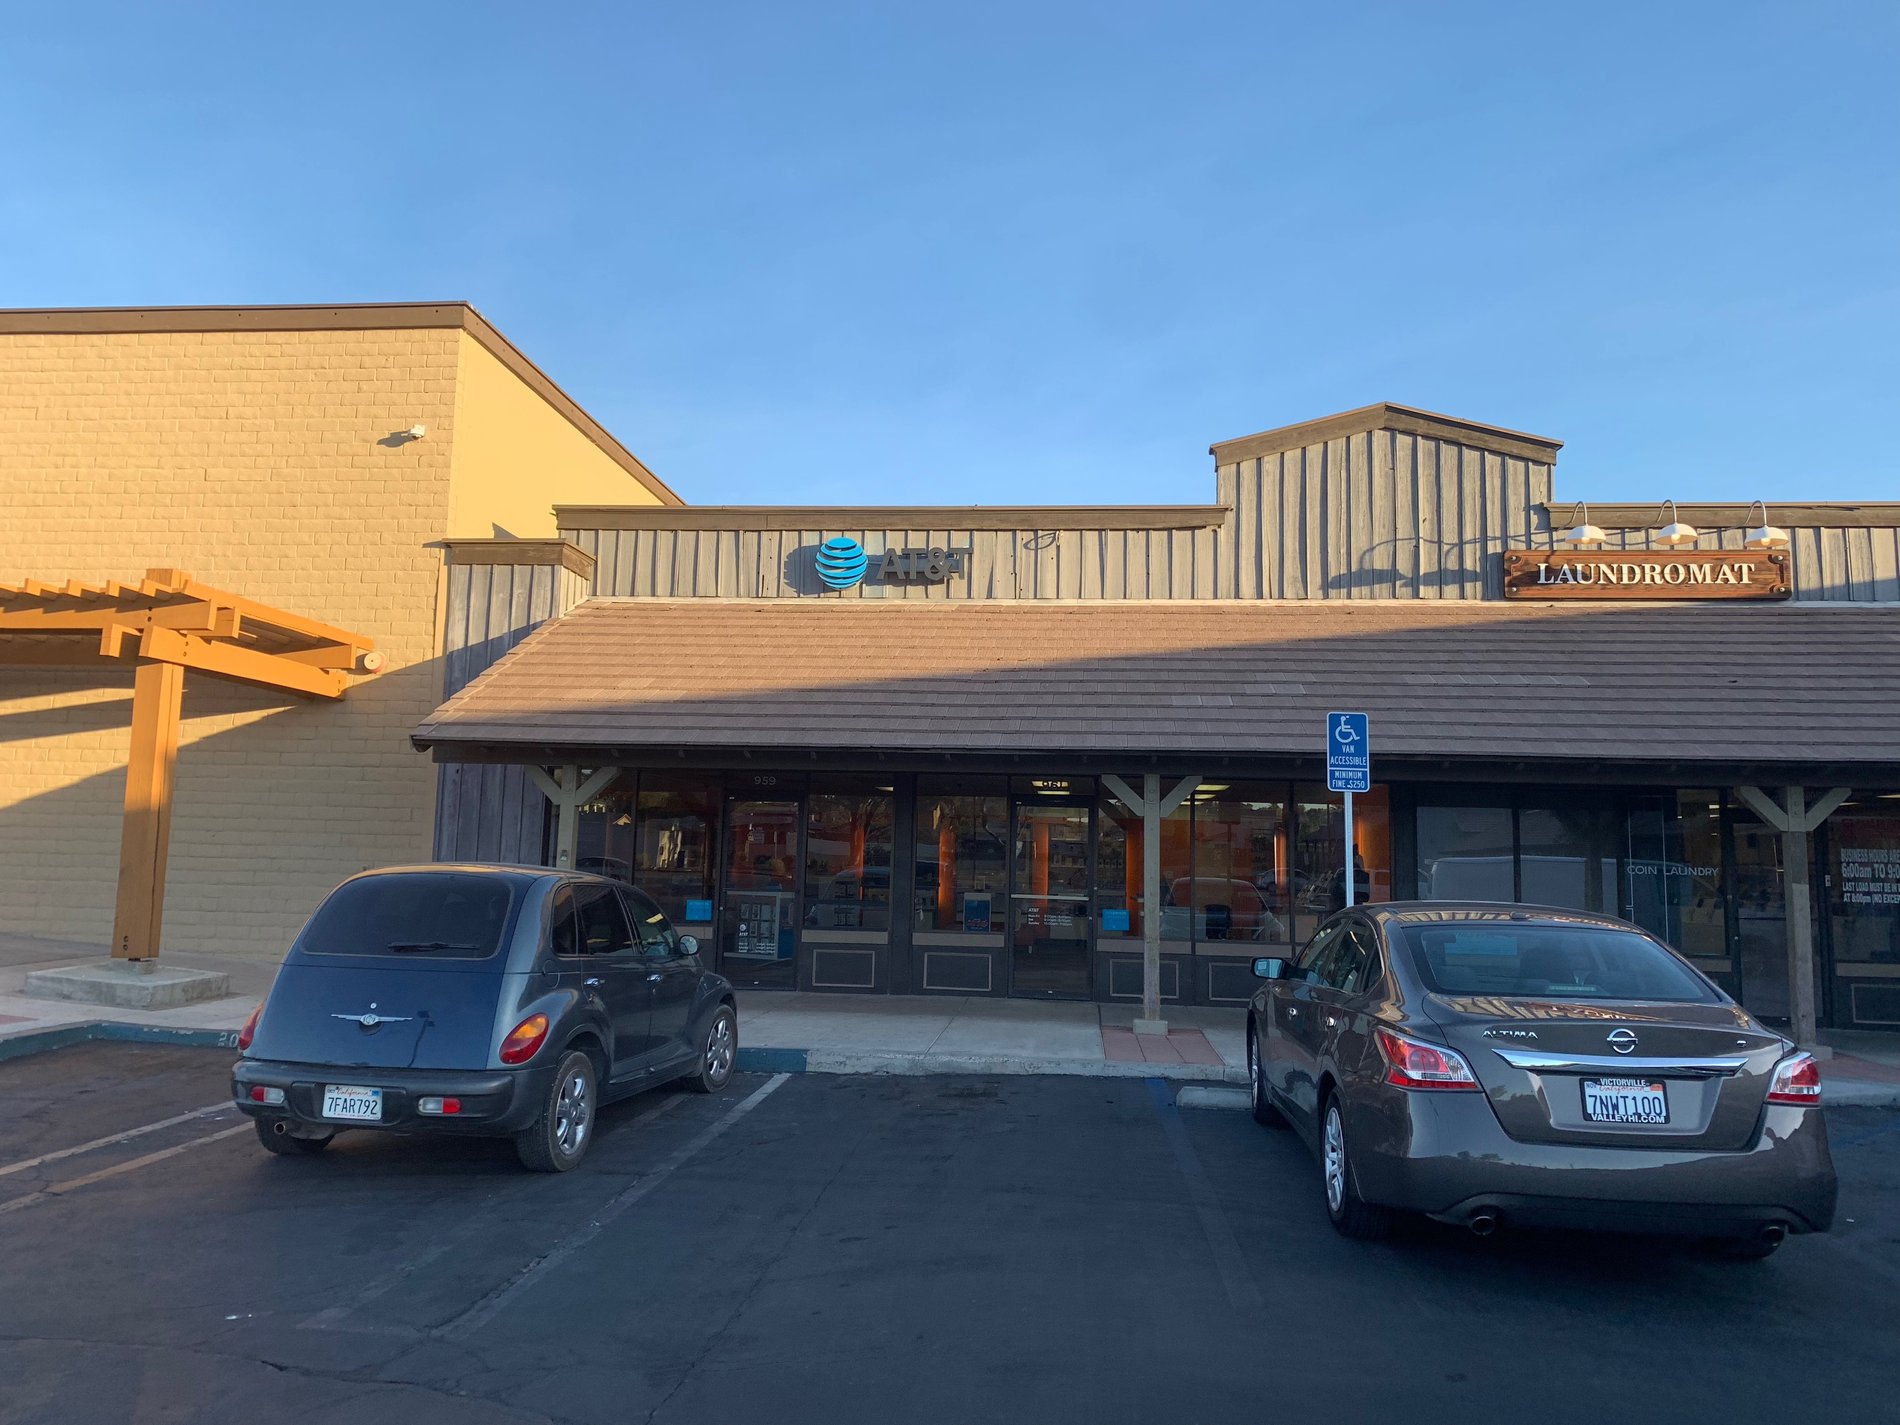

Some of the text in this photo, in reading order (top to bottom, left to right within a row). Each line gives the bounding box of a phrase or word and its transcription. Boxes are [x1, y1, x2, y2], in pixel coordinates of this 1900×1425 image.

[876, 546, 974, 581] AT&T
[1537, 563, 1755, 584] LAUNDROMAT
[1342, 745, 1354, 753] VAN
[1330, 756, 1366, 765] ACCESSIBLE
[1335, 771, 1362, 779] MINIMUM
[754, 776, 776, 785] 959
[1333, 780, 1365, 789] FINE $250
[1841, 848, 1868, 862] BUSINESS
[1869, 849, 1888, 862] HOURS
[1627, 866, 1719, 876] COIN LAUNDRY
[1842, 863, 1872, 878] 6:00am
[1873, 864, 1885, 878] TO
[1842, 882, 1855, 891] LAST
[1869, 883, 1883, 892] MUST
[1843, 893, 1851, 902] AT
[1481, 1031, 1538, 1039] ALTIMA
[336, 1087, 369, 1097] California
[328, 1097, 378, 1115] 7FAR792
[1588, 1095, 1663, 1116] 7NWT100
[1591, 1113, 1665, 1123] VALLEYHI.COM
